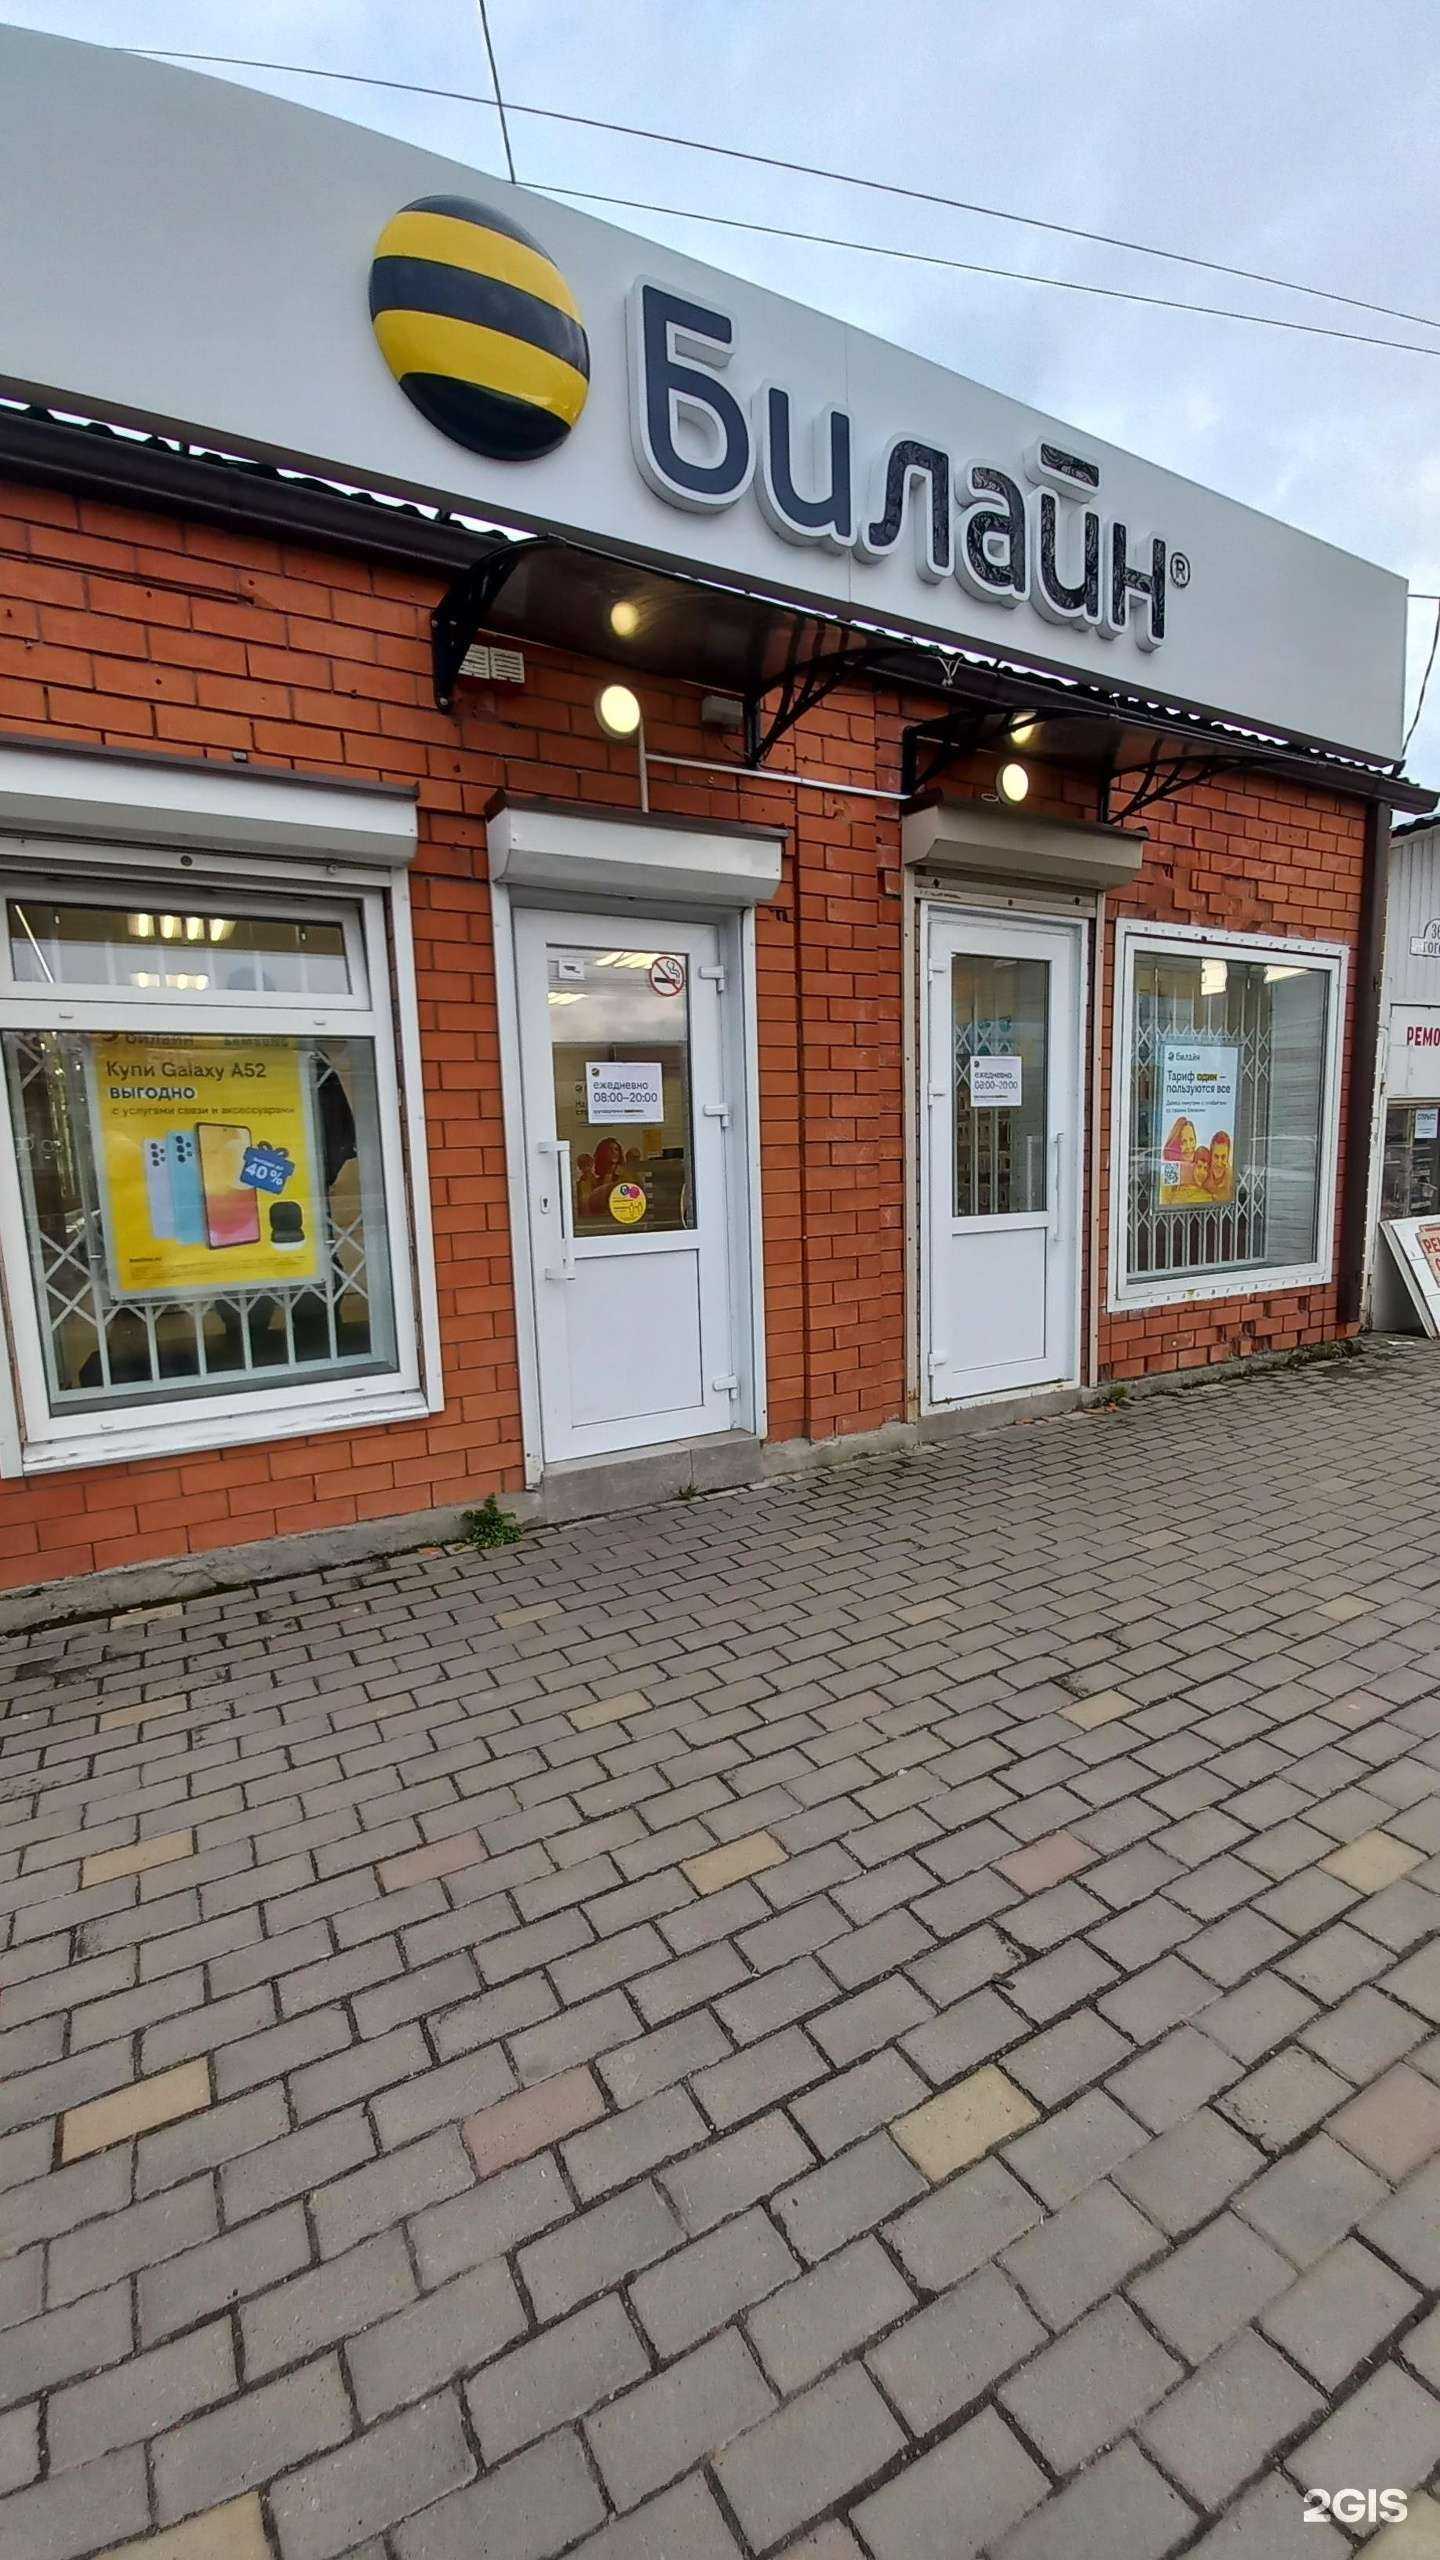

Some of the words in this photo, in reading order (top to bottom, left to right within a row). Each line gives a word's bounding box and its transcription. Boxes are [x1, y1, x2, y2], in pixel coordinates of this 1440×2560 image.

[107, 1062, 155, 1081] Купи
[162, 1063, 225, 1081] Galaxy
[231, 1063, 267, 1078] A52
[1167, 1070, 1195, 1083] Тариф
[593, 1082, 649, 1091] ежедневно
[1166, 1084, 1215, 1096] пользуются
[1216, 1085, 1231, 1094] все
[110, 1086, 197, 1100] выгодно
[123, 1107, 175, 1117] услугами
[178, 1107, 209, 1115] связи
[212, 1107, 219, 1115] и
